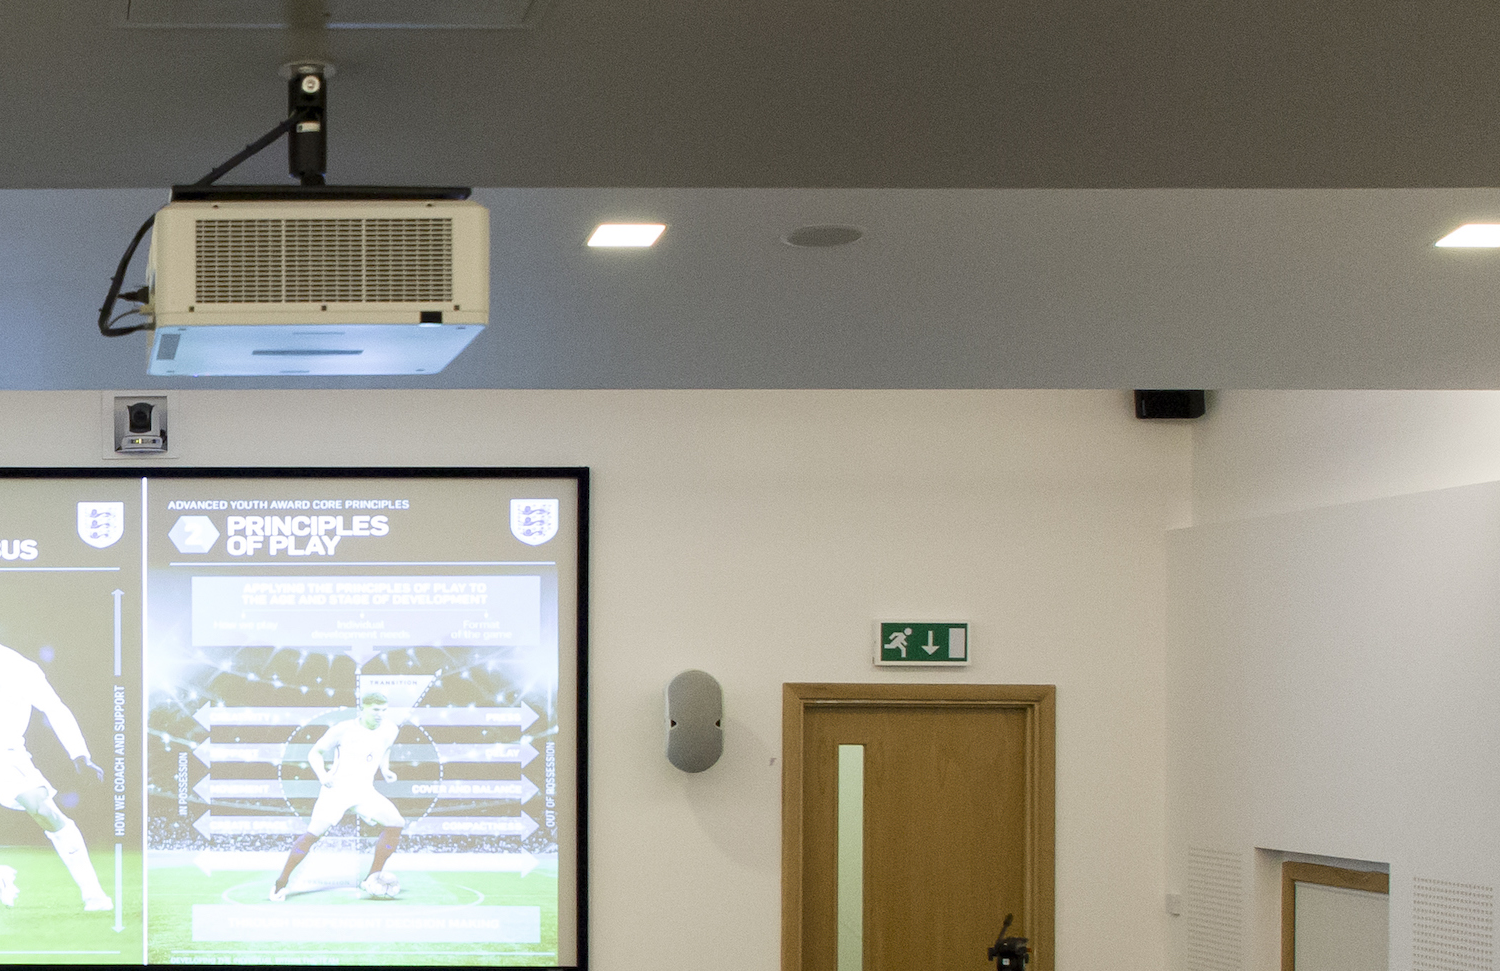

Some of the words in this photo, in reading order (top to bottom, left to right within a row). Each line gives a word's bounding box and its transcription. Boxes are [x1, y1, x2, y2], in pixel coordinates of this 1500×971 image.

[168, 500, 228, 510] ADVANCED
[230, 500, 268, 510] YOUTH
[270, 500, 310, 510] AWARD
[312, 500, 342, 510] CORE
[345, 500, 410, 510] PRINCIPLES
[227, 515, 390, 536] PRINCIPLES
[184, 522, 203, 545] 2
[226, 536, 265, 555] OF
[270, 536, 342, 555] PLAY
[243, 583, 305, 594] APPLYING
[307, 583, 333, 594] THE
[336, 583, 411, 594] PRINCIPLES
[413, 583, 431, 594] OF
[433, 583, 466, 594] PLAY
[469, 583, 487, 594] TO
[241, 594, 267, 605] THE
[269, 594, 295, 605] AGE
[298, 594, 326, 605] AND
[328, 594, 370, 605] STAGE
[373, 594, 391, 605] OF
[392, 594, 488, 605] DEVELOPMENT
[337, 620, 384, 630] Individual
[463, 620, 500, 630] Format
[451, 630, 463, 639] of
[464, 630, 481, 639] the
[483, 632, 513, 641] game
[114, 685, 125, 732] SUPPORT
[485, 713, 521, 722] PRESS
[114, 734, 125, 755] AND
[485, 749, 520, 758] DELAY
[114, 757, 125, 795] COACH
[178, 752, 188, 804] POSSESSION
[412, 785, 447, 794] COVER
[448, 785, 471, 794] AND
[472, 785, 522, 794] BALANCE
[114, 797, 125, 813] WE
[545, 796, 555, 807] OF
[178, 805, 188, 816] IN
[545, 810, 555, 827] OUT
[114, 814, 125, 836] HOW
[442, 822, 522, 831] COMPACTNESS
[228, 917, 289, 929] THROUGH
[292, 917, 382, 929] INDEPENDENT
[385, 917, 445, 929] DECISION
[448, 917, 500, 929] MAKING
